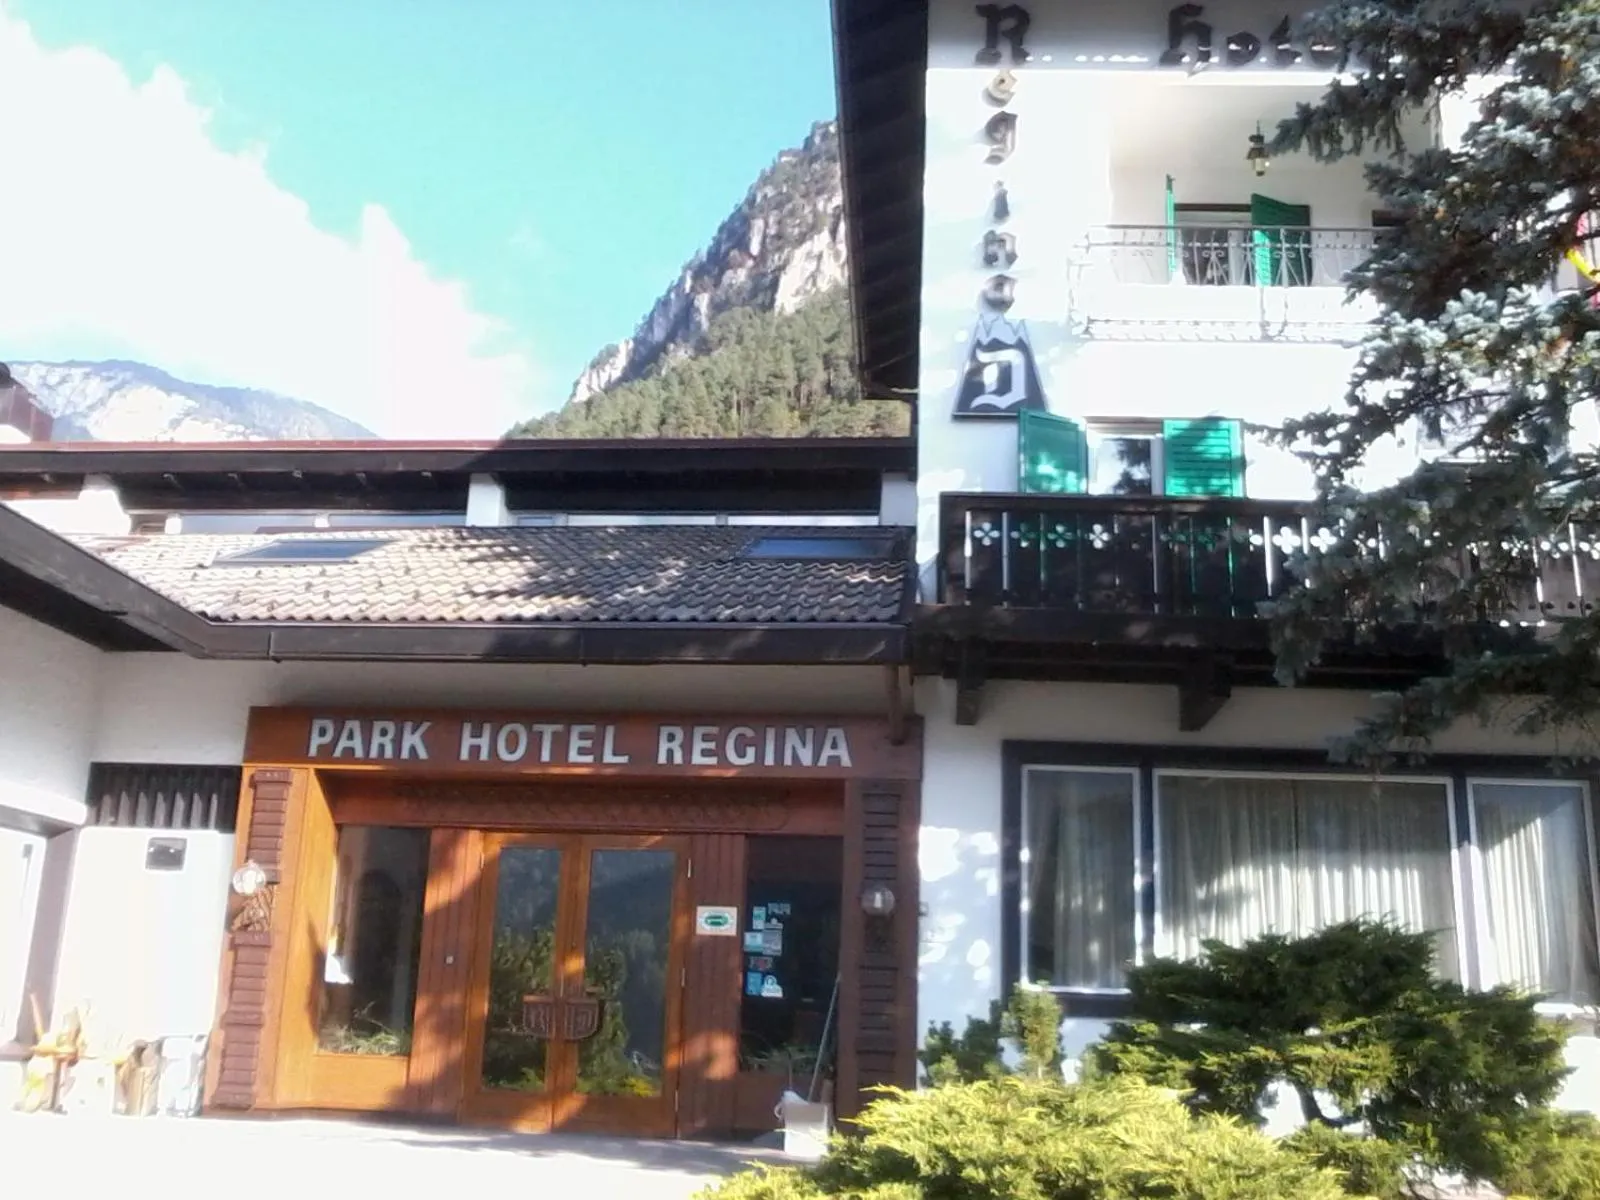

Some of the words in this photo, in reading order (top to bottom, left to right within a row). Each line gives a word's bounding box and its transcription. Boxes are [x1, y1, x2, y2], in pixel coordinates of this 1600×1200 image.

[1159, 3, 1374, 72] Hote
[308, 719, 432, 760] PARK
[459, 722, 629, 764] HOTEL
[657, 725, 852, 767] REGINA
